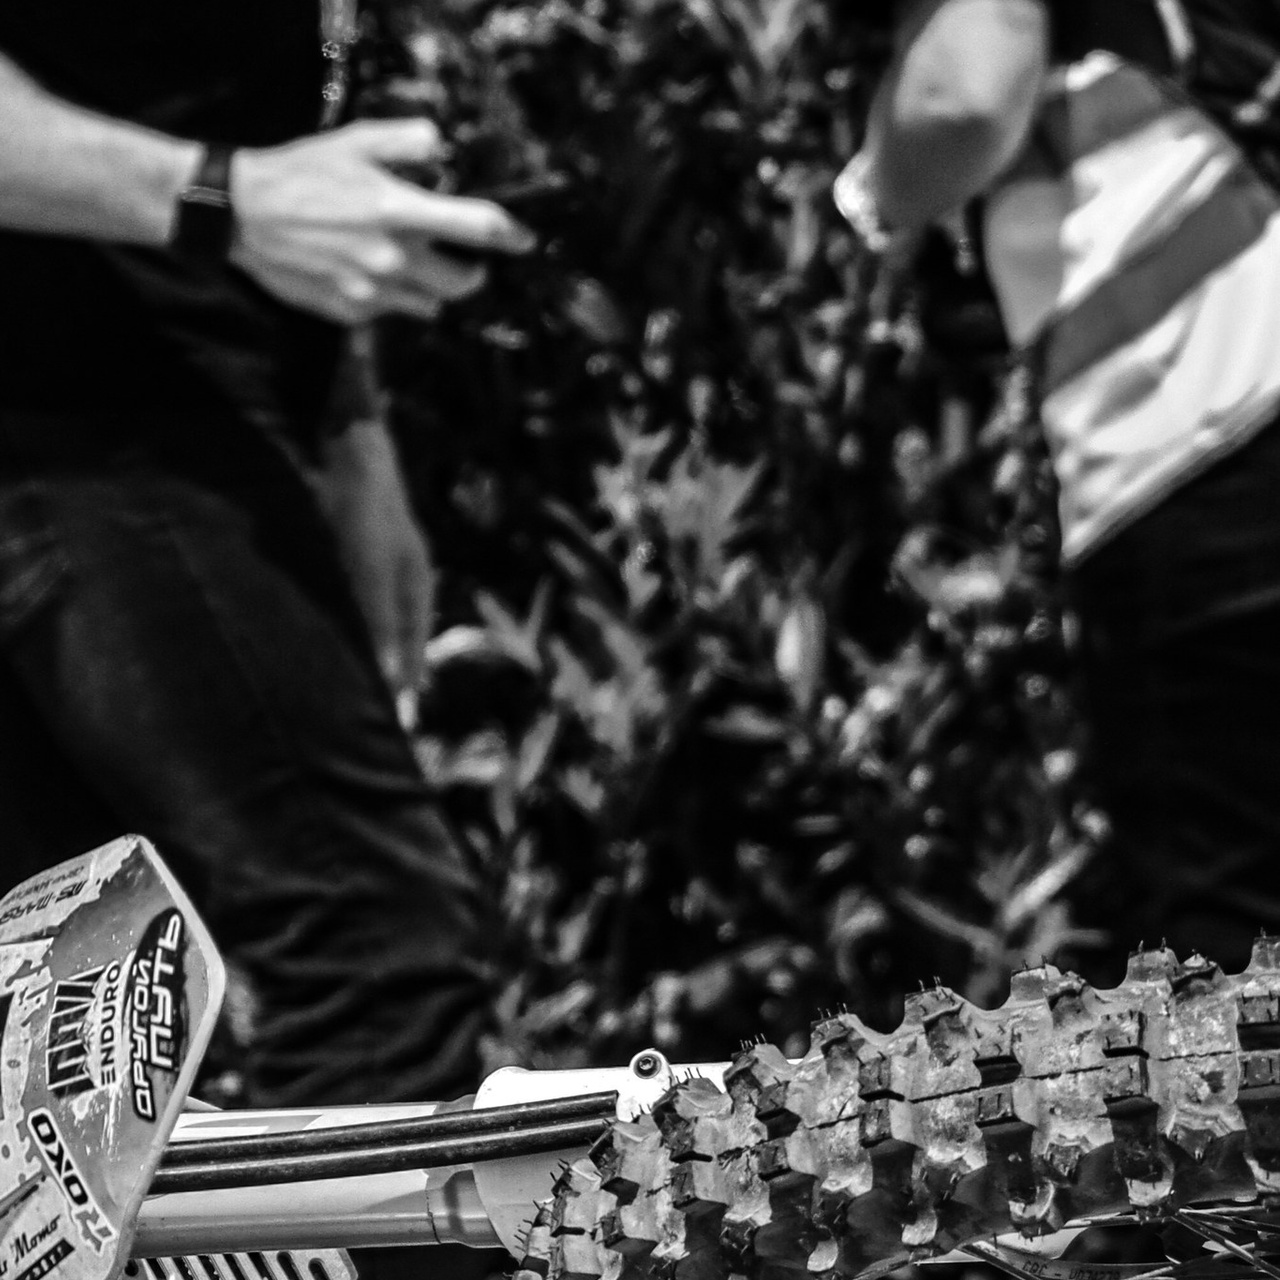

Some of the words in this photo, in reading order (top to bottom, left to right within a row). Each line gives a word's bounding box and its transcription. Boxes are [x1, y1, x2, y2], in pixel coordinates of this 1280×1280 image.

[99, 964, 121, 1087] ENDURO
[131, 958, 153, 1117] ДРУГОЙ
[149, 914, 181, 1068] ПУТЬ
[11, 1213, 63, 1267] Мото
